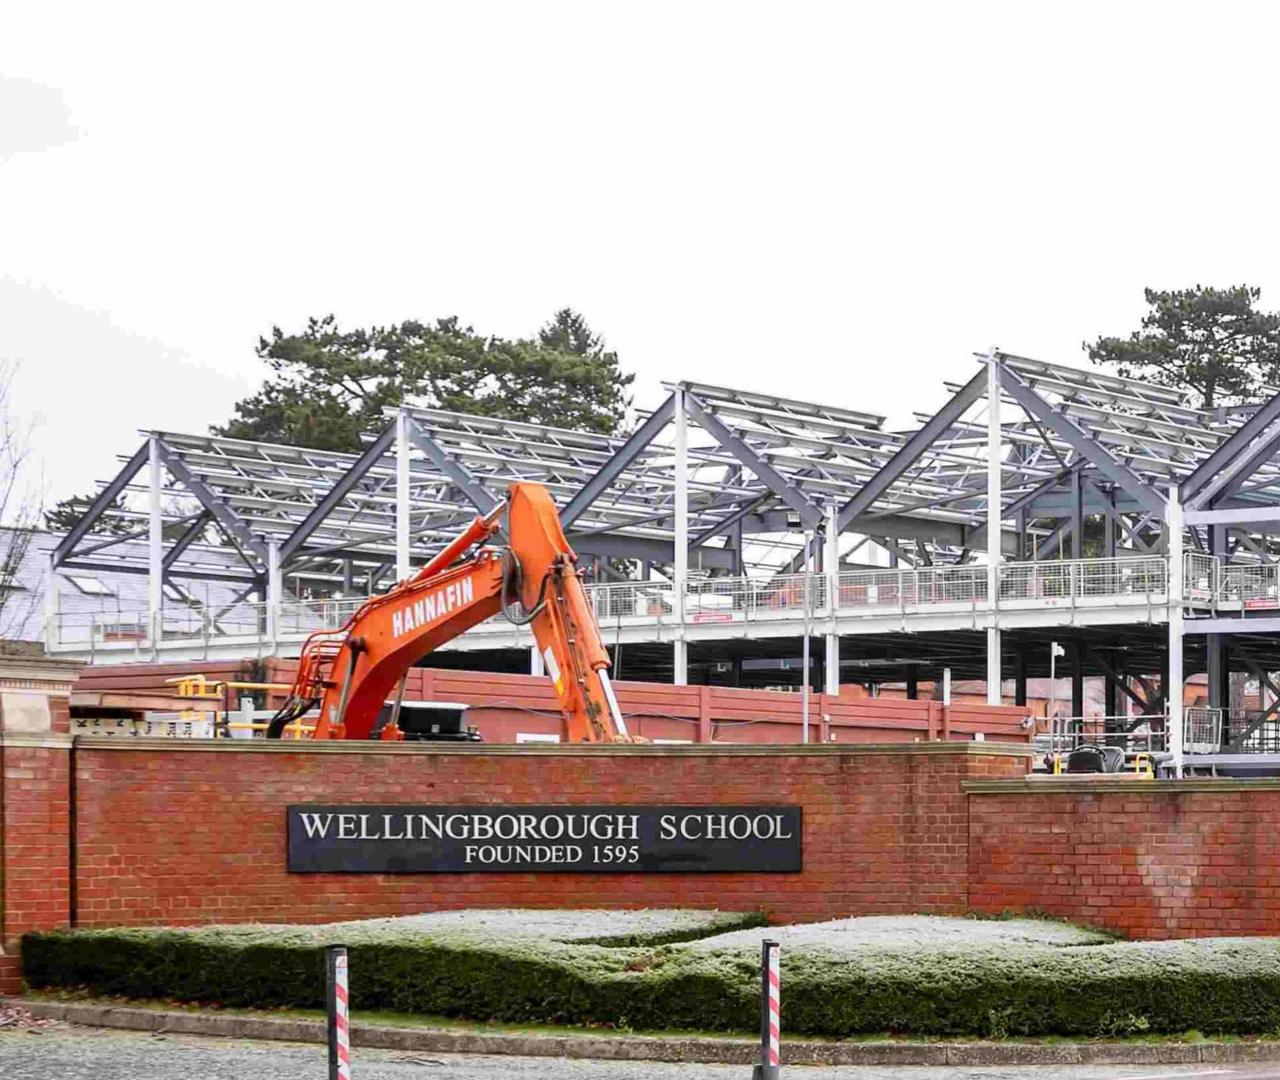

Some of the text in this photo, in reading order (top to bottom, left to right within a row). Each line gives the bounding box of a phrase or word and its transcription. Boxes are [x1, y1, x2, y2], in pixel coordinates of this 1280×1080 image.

[392, 576, 474, 638] HANNAFIN
[299, 812, 792, 840] WELLINGBOROUGH SCHOOL
[464, 845, 639, 863] FOUNDED 1595
